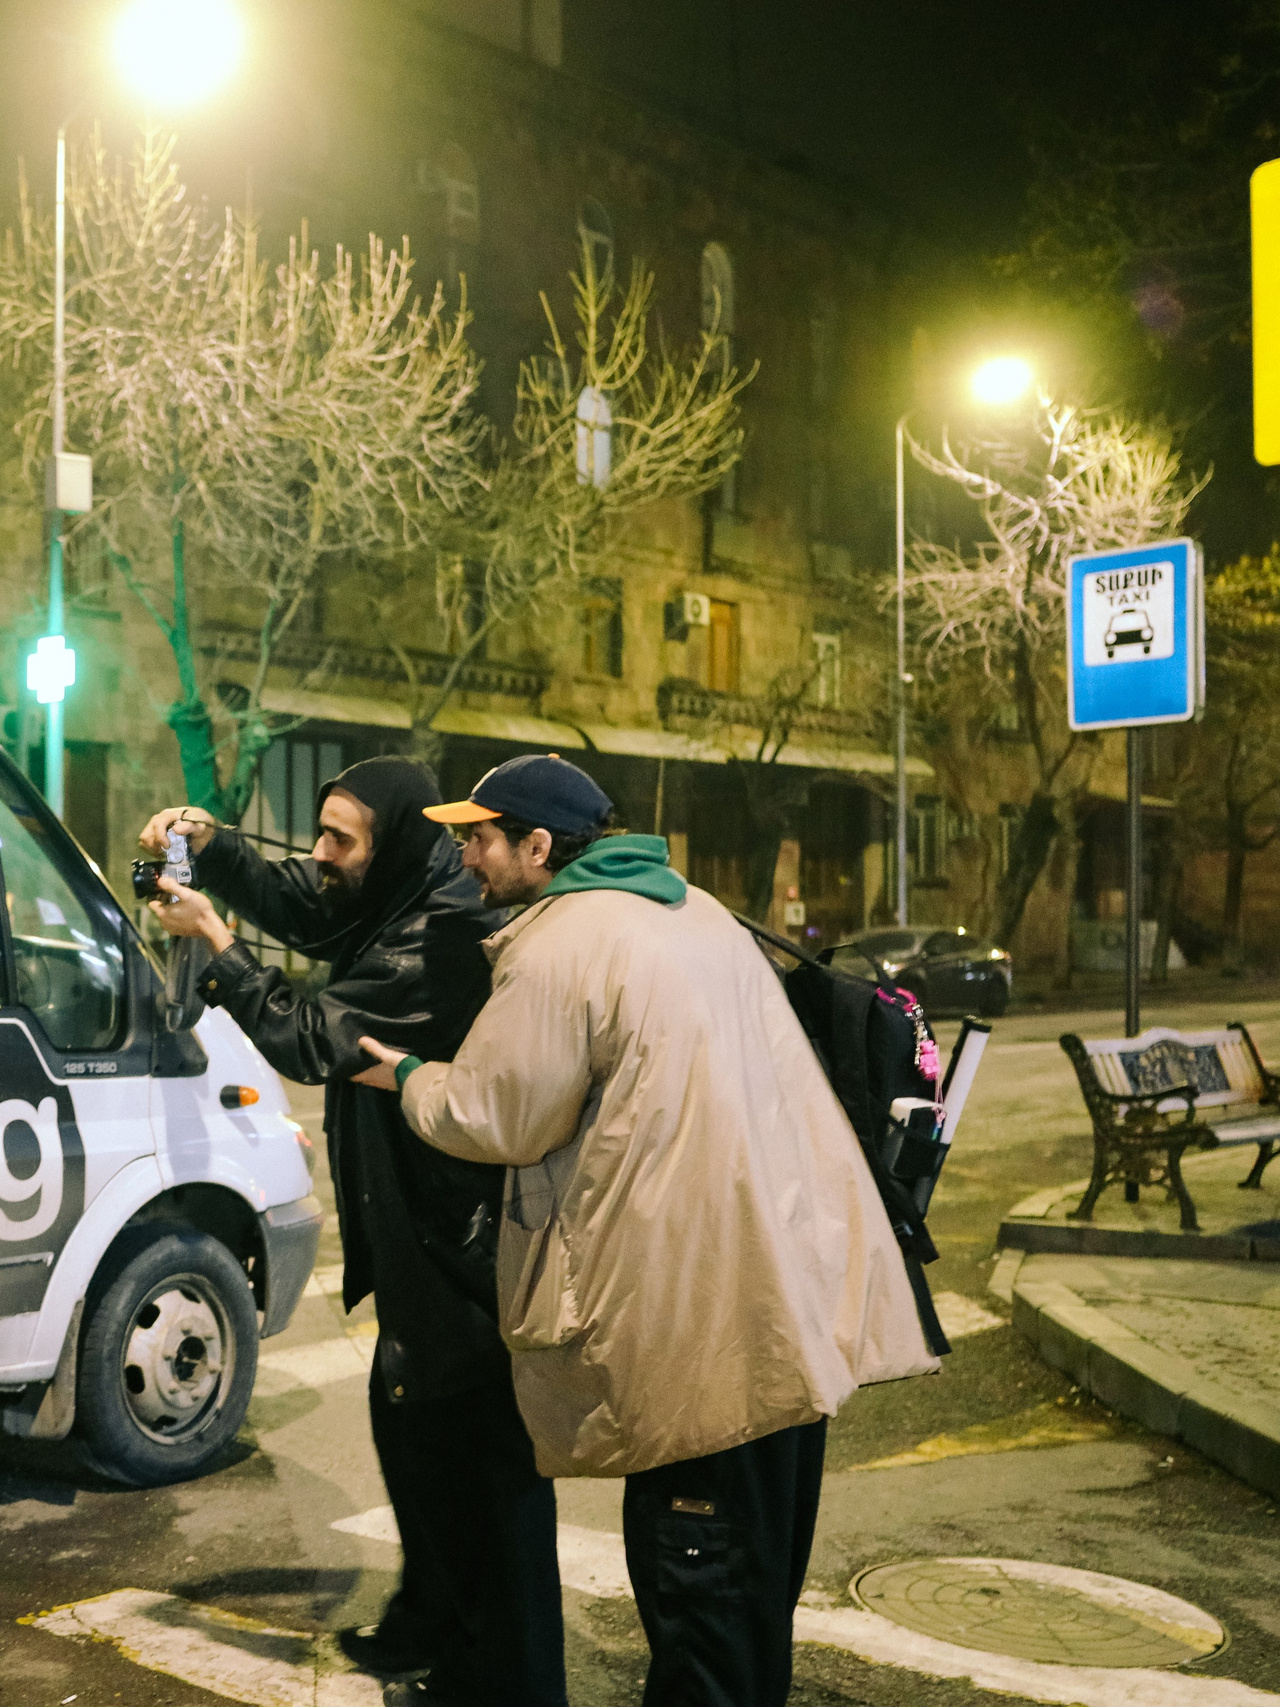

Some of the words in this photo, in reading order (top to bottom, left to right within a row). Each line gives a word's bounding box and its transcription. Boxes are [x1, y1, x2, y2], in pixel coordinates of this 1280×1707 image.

[1095, 567, 1163, 594] ՏԱՔՍԻ
[1108, 590, 1150, 606] TAXI
[63, 1061, 86, 1075] 125
